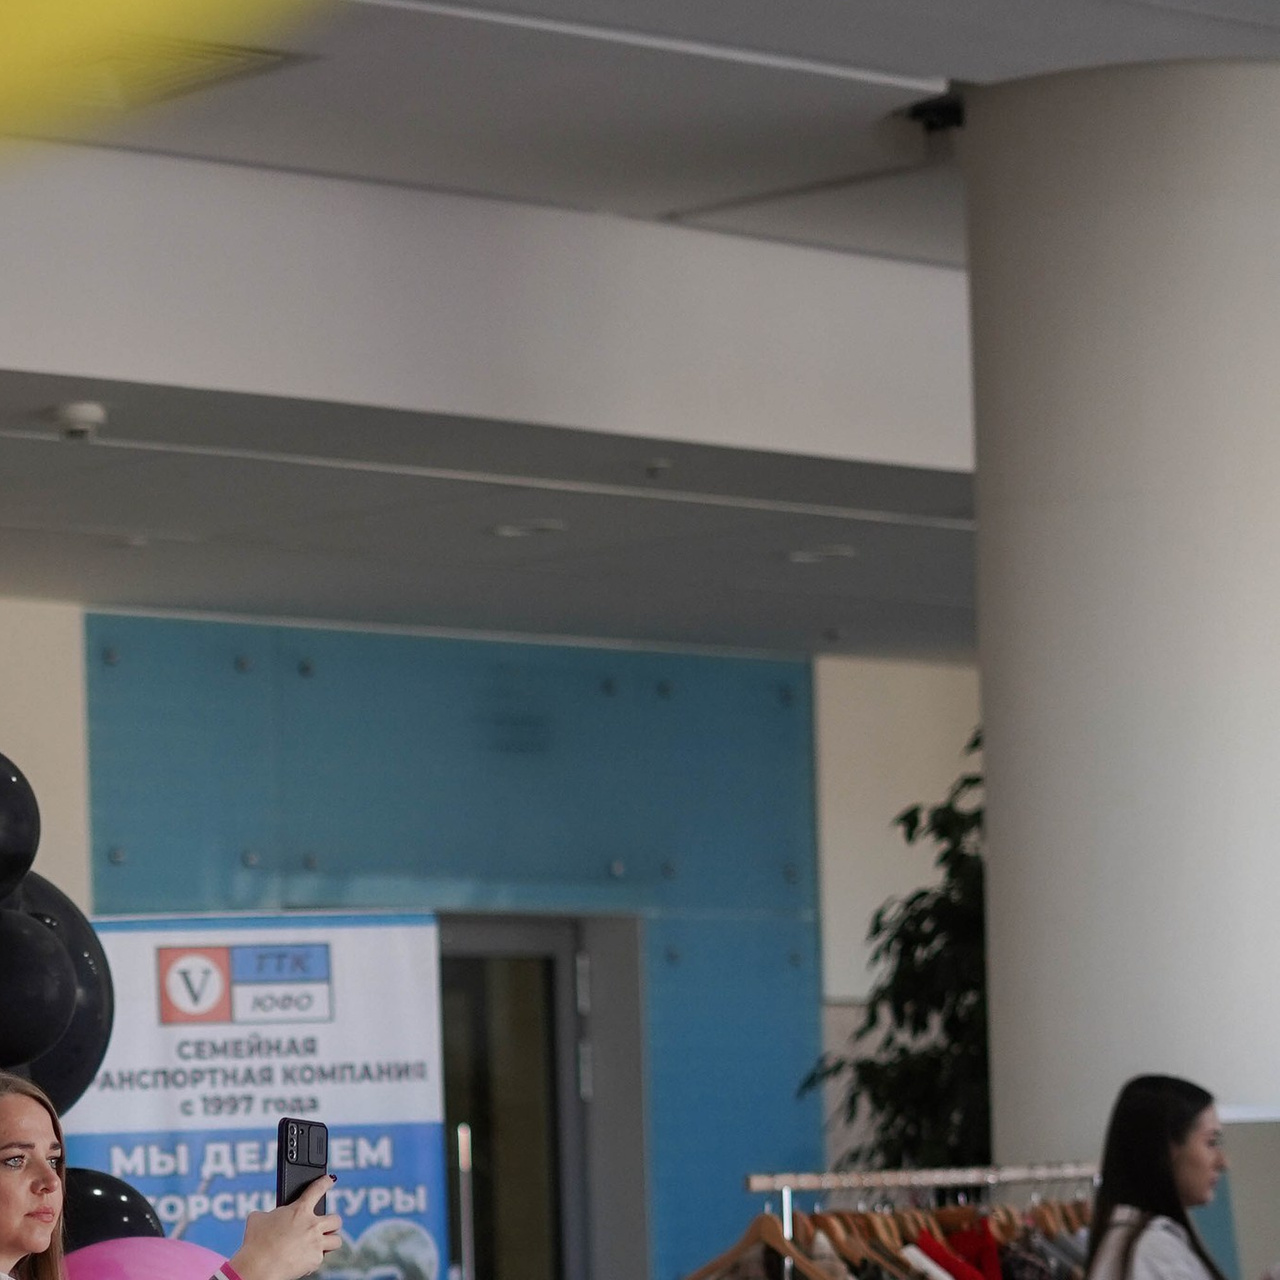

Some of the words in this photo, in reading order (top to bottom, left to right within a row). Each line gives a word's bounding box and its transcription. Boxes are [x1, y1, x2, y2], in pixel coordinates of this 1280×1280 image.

[177, 1032, 318, 1060] СЕМЕЙНАЯ
[95, 1065, 275, 1091] АНСПОРТНАЯ
[282, 1061, 427, 1085] КОМПАНИЯ
[180, 1100, 194, 1116] с
[201, 1094, 254, 1116] 1997
[263, 1096, 319, 1115] года
[110, 1143, 190, 1178] МЫ
